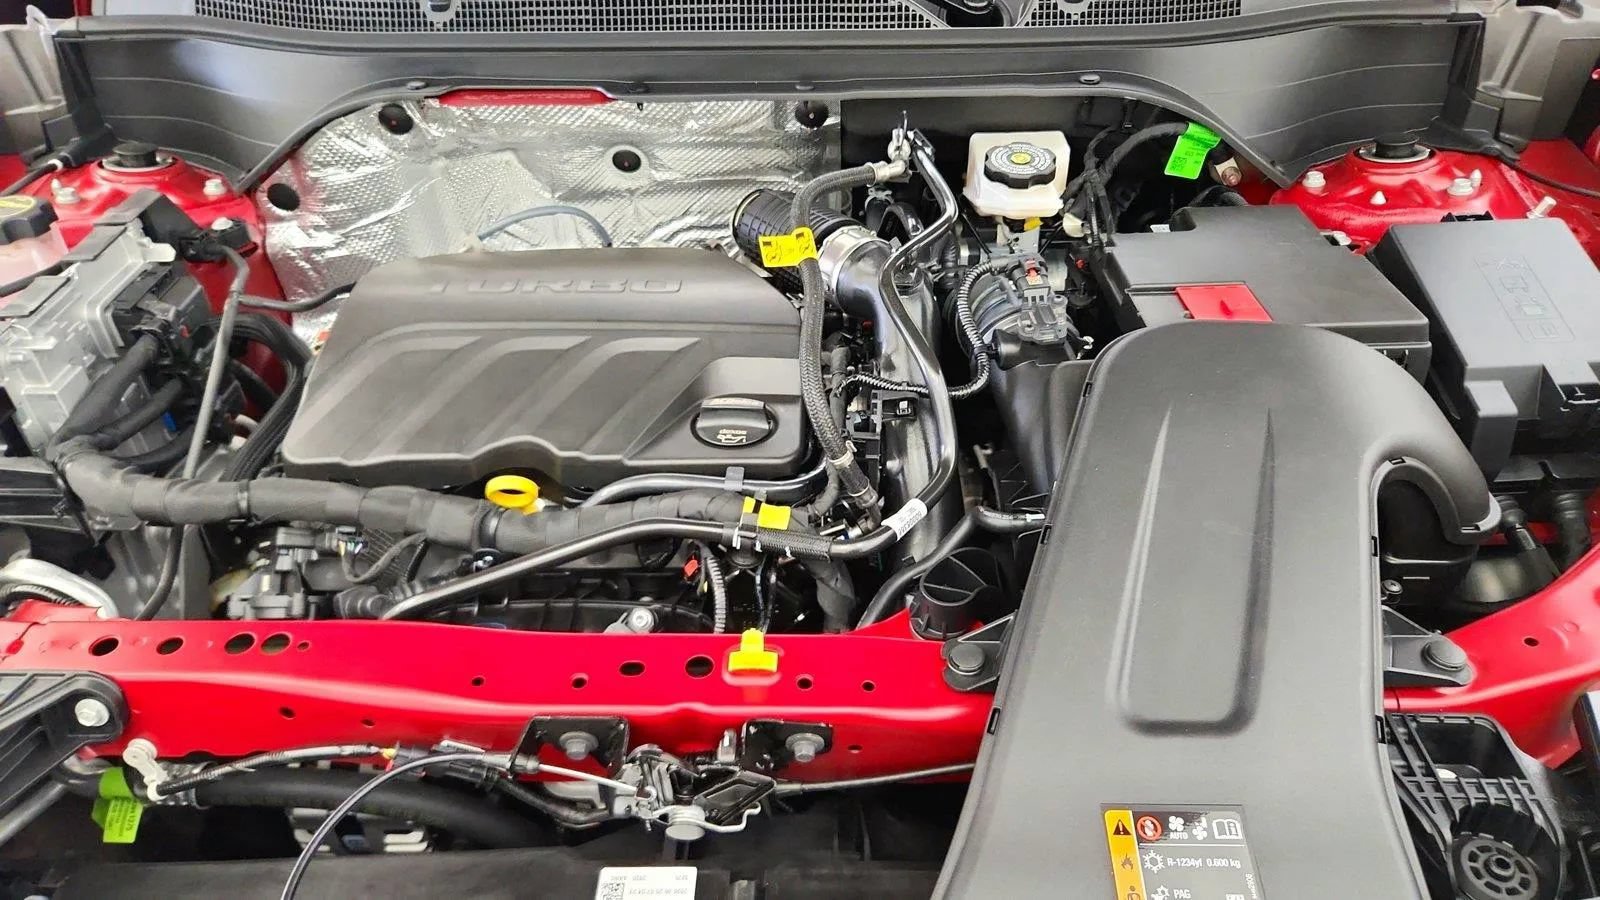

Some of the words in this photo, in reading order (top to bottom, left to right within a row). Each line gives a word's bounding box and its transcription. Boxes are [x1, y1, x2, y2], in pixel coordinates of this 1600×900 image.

[427, 277, 683, 294] TURBO
[1170, 831, 1188, 840] AUTO
[1230, 858, 1241, 869] kg
[1173, 889, 1192, 899] PAG
